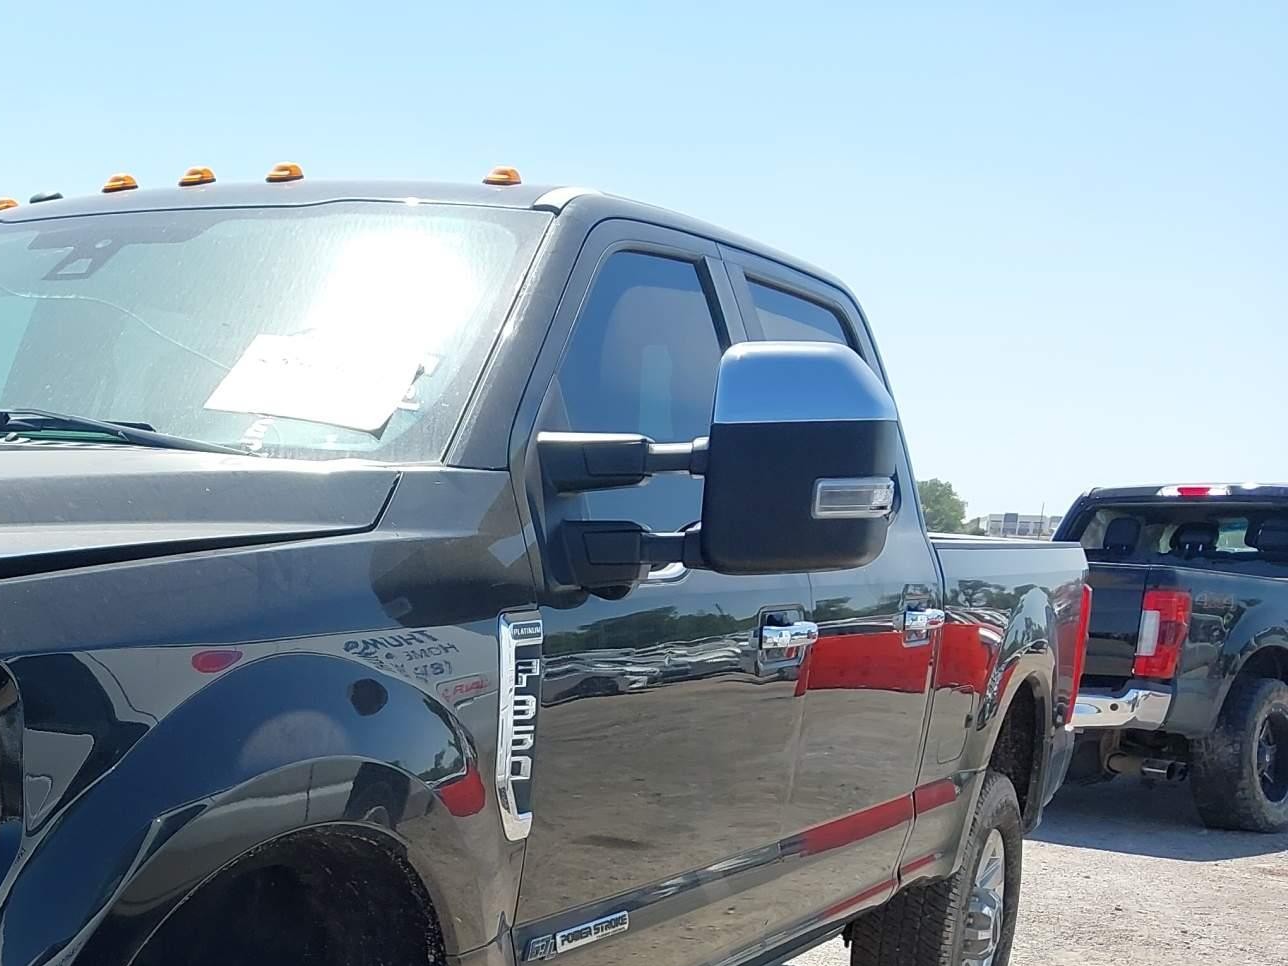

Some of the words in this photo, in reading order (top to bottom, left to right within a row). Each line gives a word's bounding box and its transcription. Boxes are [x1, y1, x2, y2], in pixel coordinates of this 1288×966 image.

[513, 626, 541, 636] PLATINUM
[559, 924, 592, 947] POWER
[593, 914, 628, 934] STROKE
